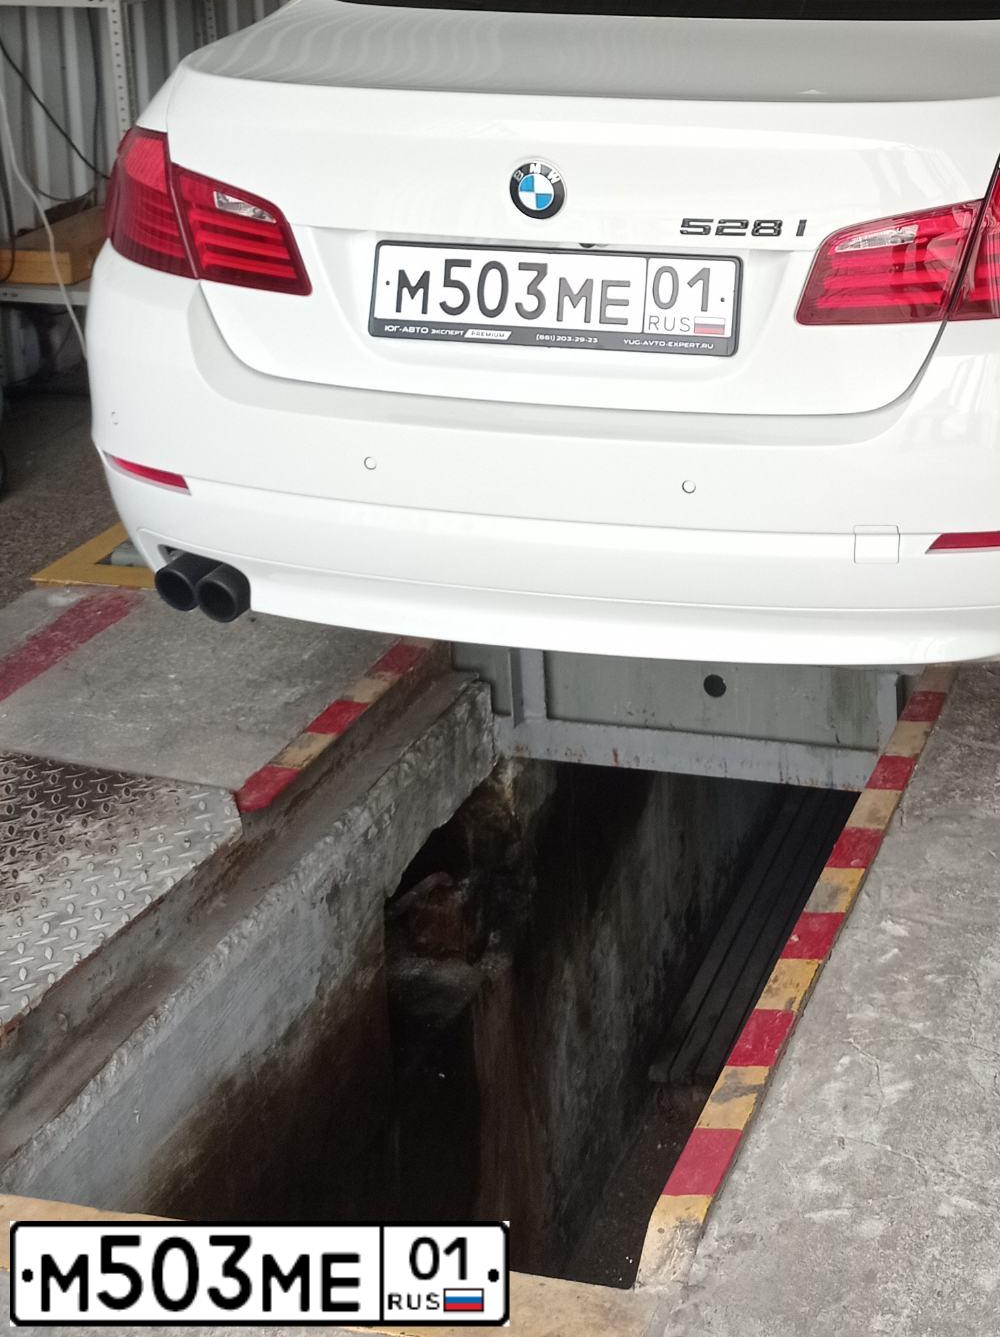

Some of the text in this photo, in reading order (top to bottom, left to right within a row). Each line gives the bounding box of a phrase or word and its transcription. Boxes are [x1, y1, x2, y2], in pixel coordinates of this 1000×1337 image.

[513, 162, 561, 184] BMW
[652, 265, 711, 313] 01
[384, 324, 430, 335] ЮГ-АВТО
[470, 330, 506, 339] PREMIUM
[649, 315, 691, 333] RUS
